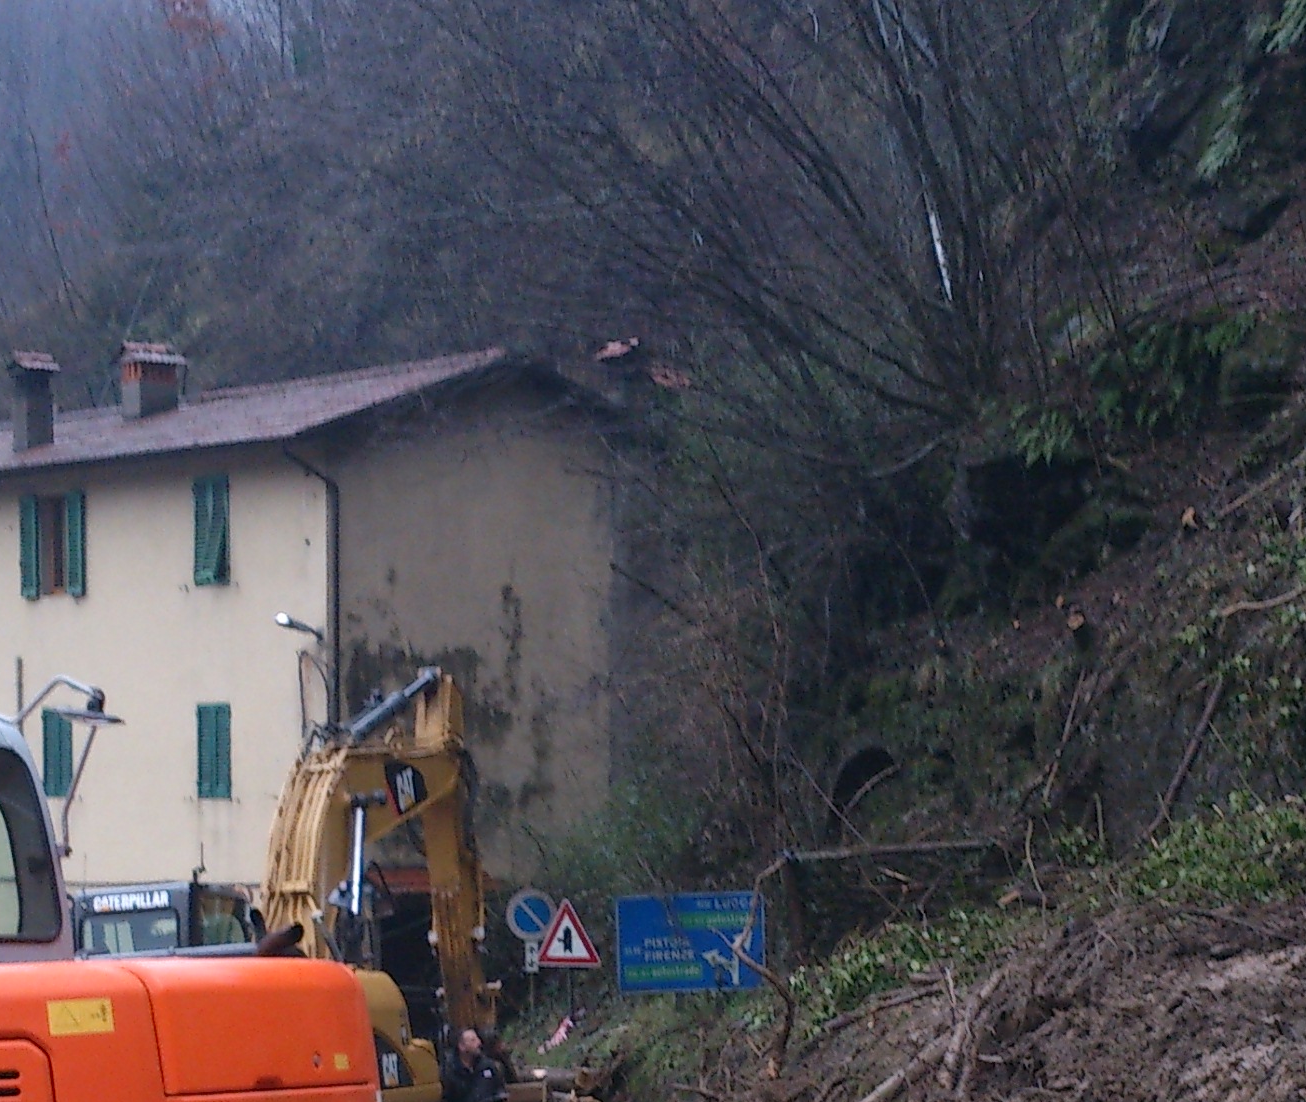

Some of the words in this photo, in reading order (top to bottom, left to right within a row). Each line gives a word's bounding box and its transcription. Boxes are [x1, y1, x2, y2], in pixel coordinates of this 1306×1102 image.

[396, 767, 415, 812] CAT
[93, 890, 169, 912] CATERPILLAR
[382, 1052, 399, 1087] CAT
